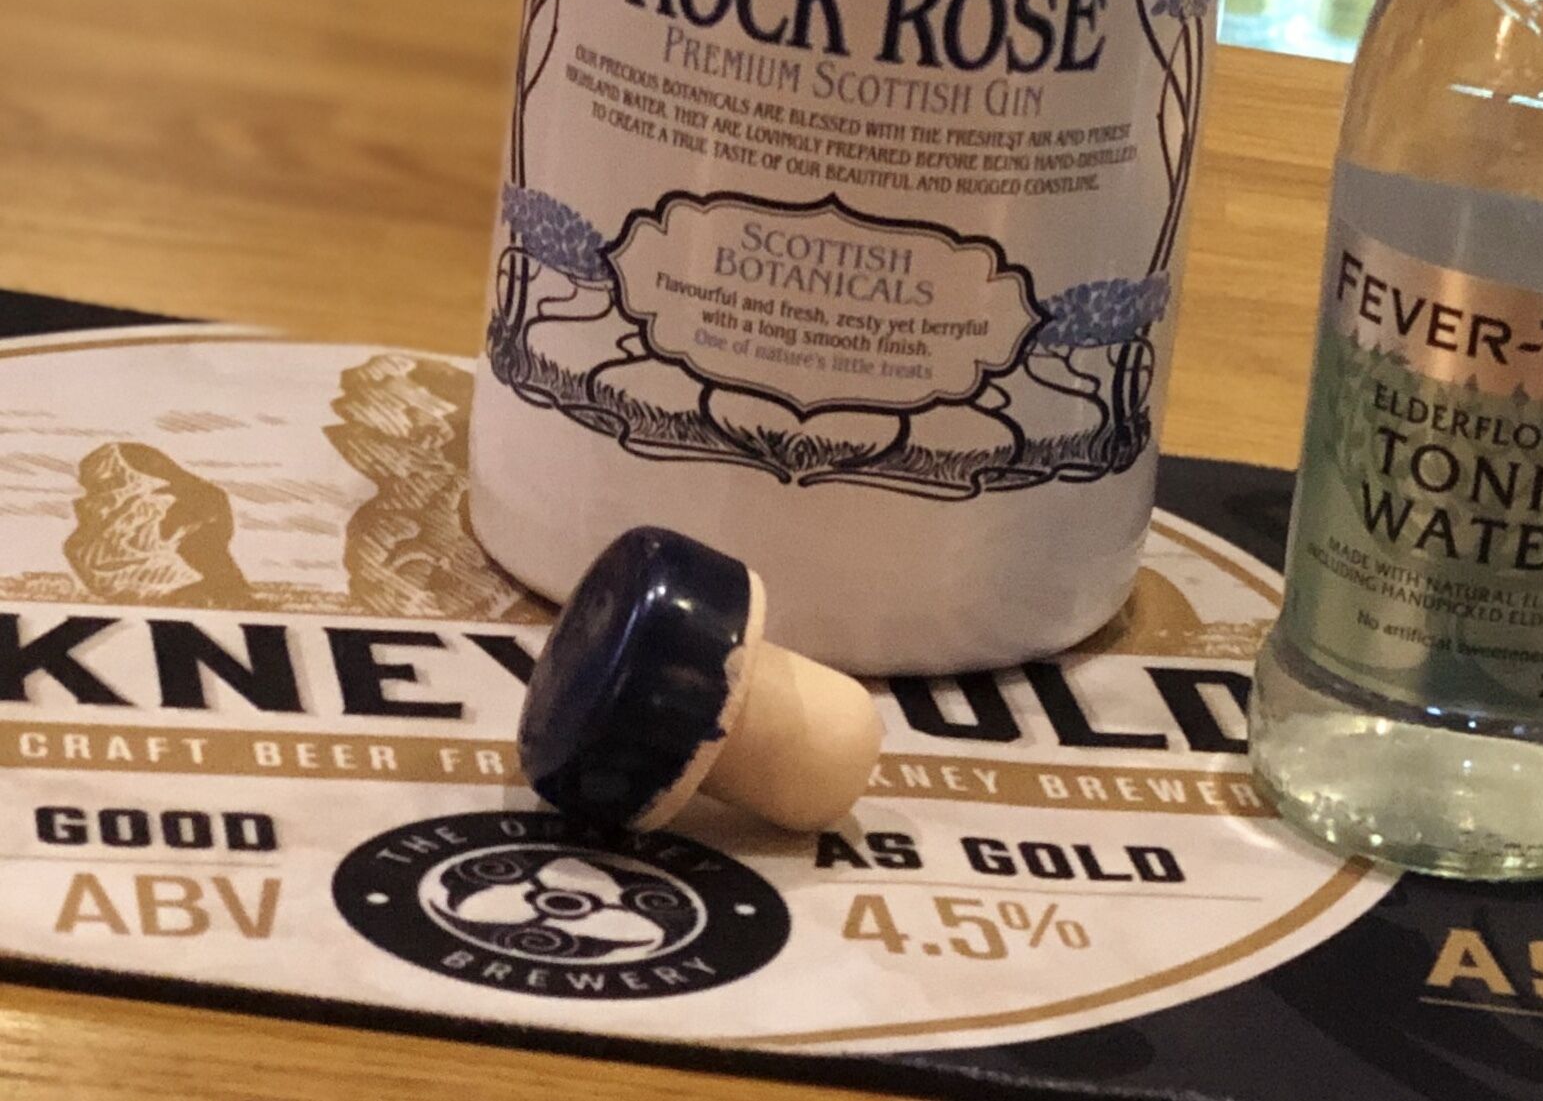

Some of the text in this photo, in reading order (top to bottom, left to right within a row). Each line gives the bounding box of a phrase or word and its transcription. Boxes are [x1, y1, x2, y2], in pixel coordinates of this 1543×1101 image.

[575, 44, 597, 69] OUR
[599, 54, 658, 89] PRECIOUS
[663, 77, 749, 115] BOTANICALS
[753, 101, 785, 123] ARE
[788, 108, 861, 135] BLESSED
[865, 119, 905, 142] WITH
[911, 125, 941, 144] THE
[1028, 130, 1051, 147] AIR
[1056, 129, 1084, 147] AND
[662, 25, 1045, 118] PREMIUM SCOTTISH GIN
[592, 101, 606, 120] TO
[608, 108, 655, 139] CREATE
[657, 127, 668, 142] A
[672, 129, 708, 154] TRUE
[713, 140, 757, 166] TASTE
[761, 152, 782, 170] OF
[786, 156, 820, 178] OUR
[825, 163, 913, 191] BEAUTIFUL
[916, 175, 952, 194] AND
[956, 176, 1021, 195] RUGGED
[674, 104, 709, 130] THEY
[712, 115, 741, 138] ARE
[746, 122, 822, 154] LOVINGLY
[826, 139, 911, 165] PREPARED
[916, 149, 978, 170] BEFORE
[982, 153, 1029, 172] BEING
[714, 245, 934, 306] BOTANICALS
[741, 223, 912, 275] SCOTTISH
[656, 271, 988, 341] Flavourful and fresh, zesty yet berryful
[702, 309, 932, 357] with a long smooth finish.
[694, 328, 727, 348] One
[732, 336, 748, 354] of
[832, 354, 874, 373] little
[881, 361, 932, 379] treats
[1328, 535, 1370, 569] MADE
[1375, 559, 1420, 587] WITH
[1426, 577, 1516, 607] NATURAL
[1357, 609, 1379, 630] No
[1383, 624, 1452, 650] artificial
[1380, 582, 1502, 622] HANDPICKED
[19, 732, 1262, 809] CRAFT BEER FR KNEY BREWER
[34, 805, 276, 852] GOOD
[376, 825, 468, 864] THE
[814, 831, 1185, 884] AS GOLD
[54, 872, 281, 940] ABV
[841, 893, 1091, 960] 4.5%
[441, 950, 719, 992] BREWERY
